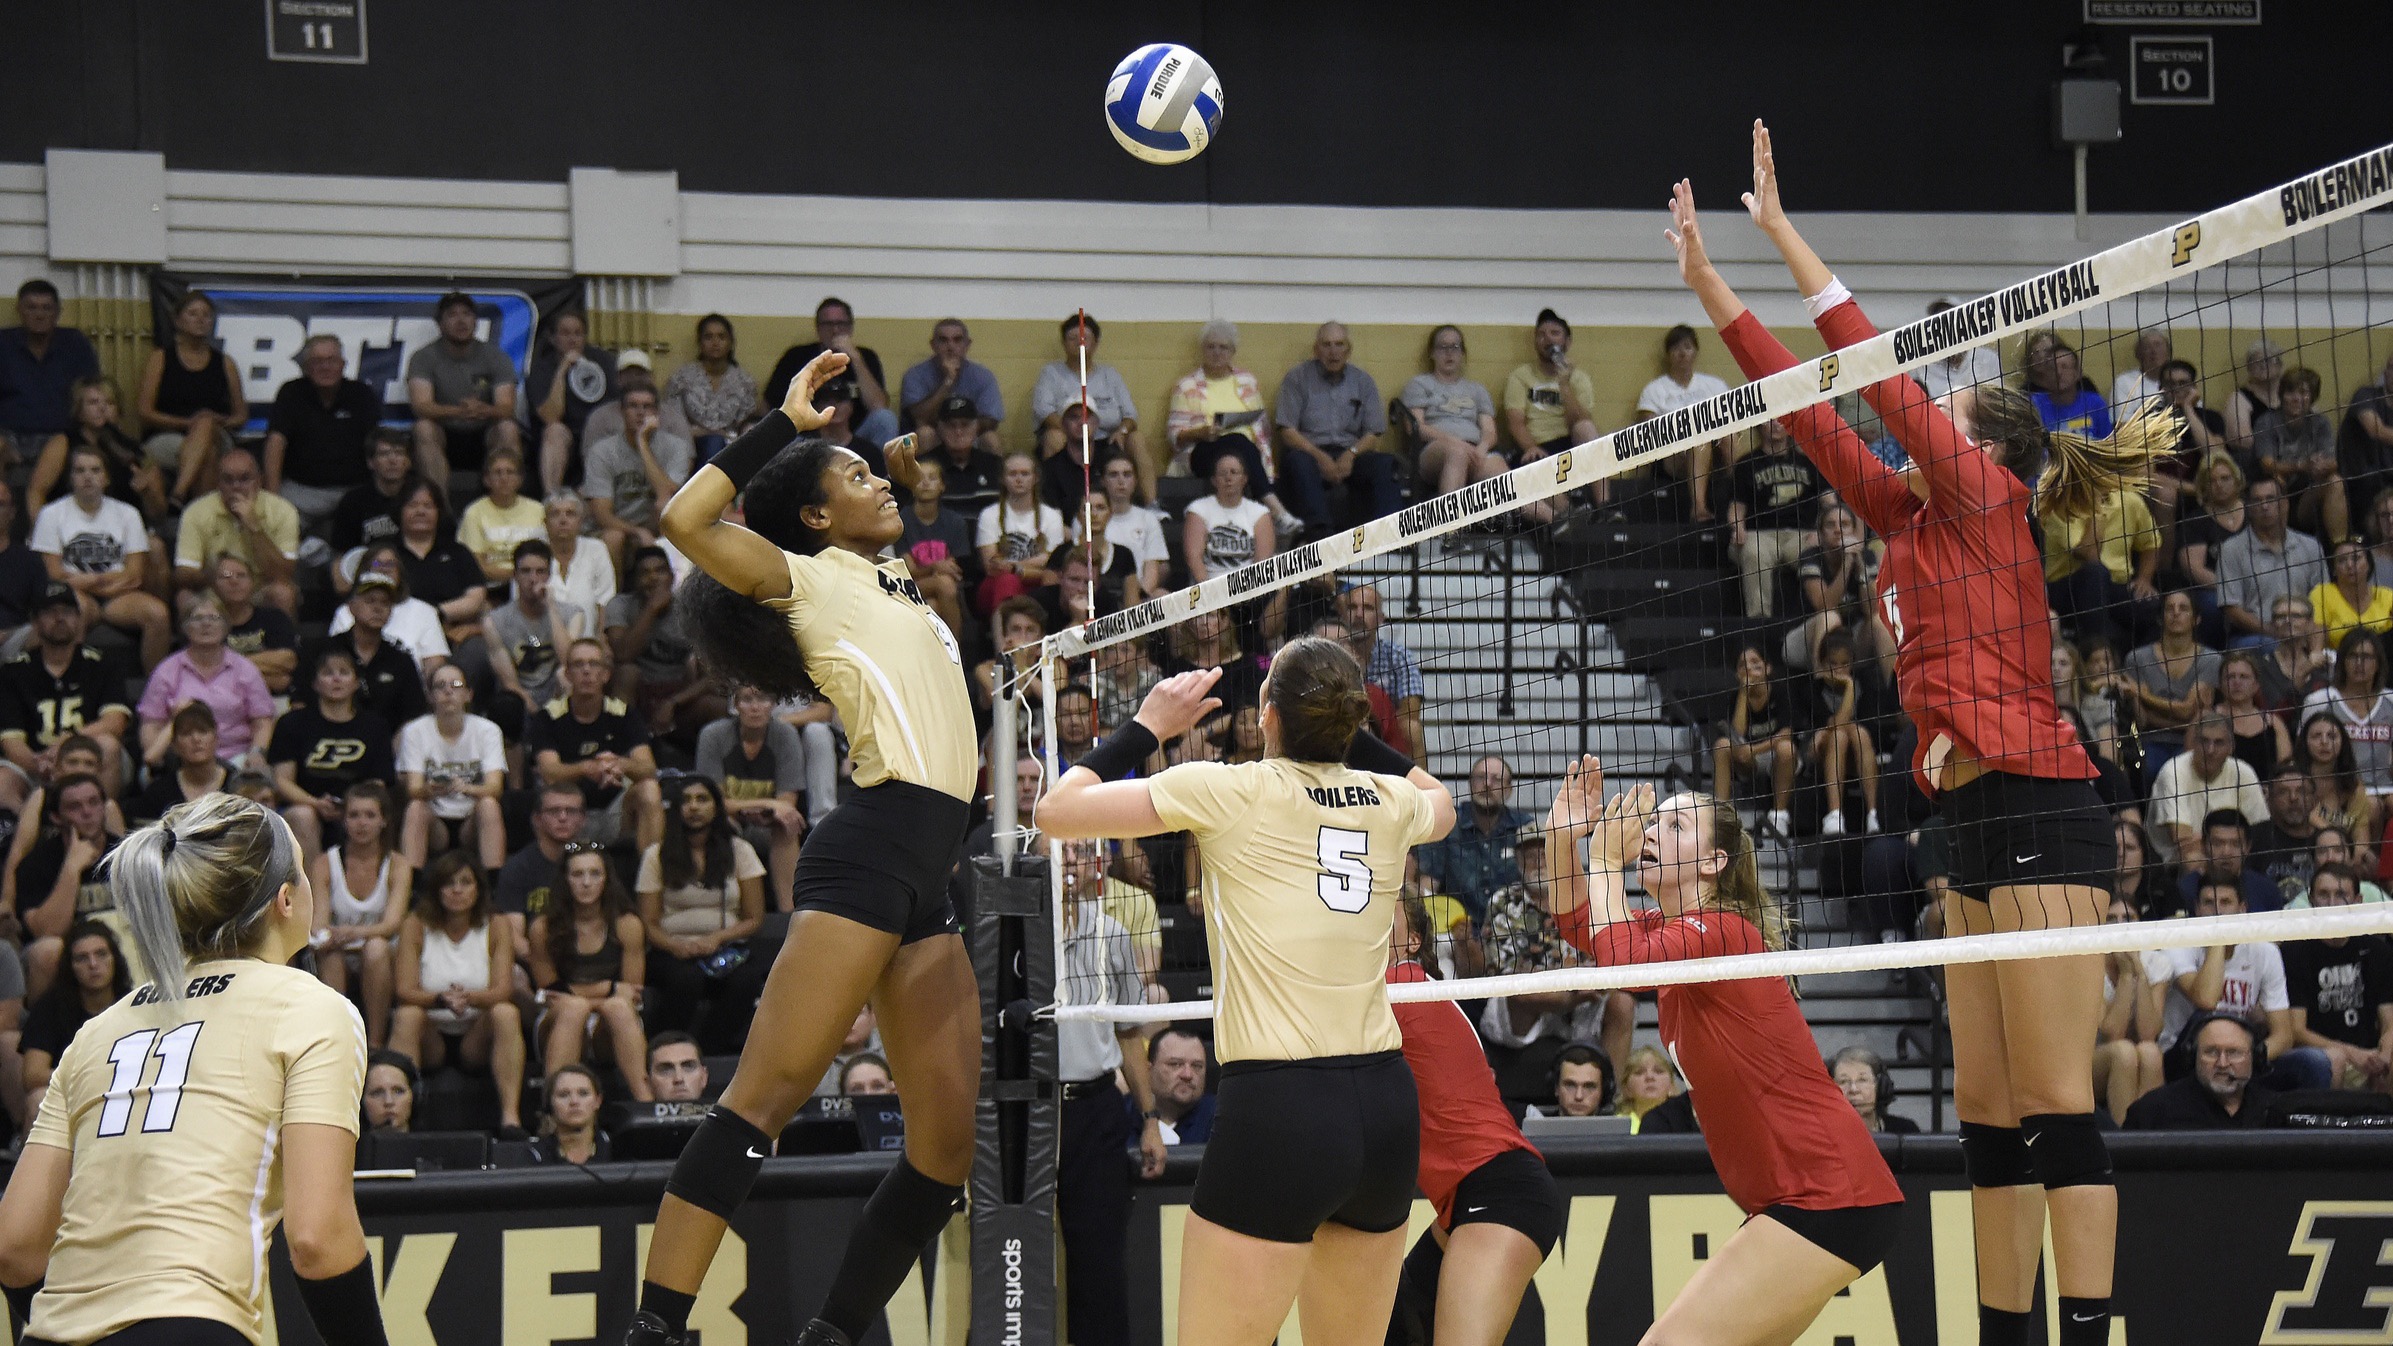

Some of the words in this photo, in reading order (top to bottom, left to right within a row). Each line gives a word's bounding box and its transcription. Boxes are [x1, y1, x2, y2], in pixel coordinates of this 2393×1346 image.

[2092, 3, 2179, 16] RESERVED
[2181, 3, 2254, 16] SEATING
[303, 22, 333, 49] 11
[2142, 48, 2203, 62] SECTION
[1150, 58, 1182, 100] PURDUE
[2159, 68, 2192, 92] 10
[2172, 220, 2200, 268] P
[1893, 295, 1997, 365] BOILERMAKER
[2000, 259, 2100, 327] VOLLEYBALL
[1819, 353, 1840, 392] P
[1613, 408, 1692, 461] BOILERMAKER
[1692, 382, 1767, 434] VOLLEYBALL
[1556, 451, 1572, 483] P
[1398, 492, 1459, 537] BOILERMAKER
[1460, 472, 1517, 517] VOLLEYBALL
[1352, 526, 1364, 553] P
[1189, 585, 1200, 610] P
[306, 738, 366, 770] P
[1317, 824, 1373, 914] 5
[130, 974, 236, 1007] BOERS
[97, 1020, 206, 1138] 11
[1001, 1238, 1024, 1309] sports
